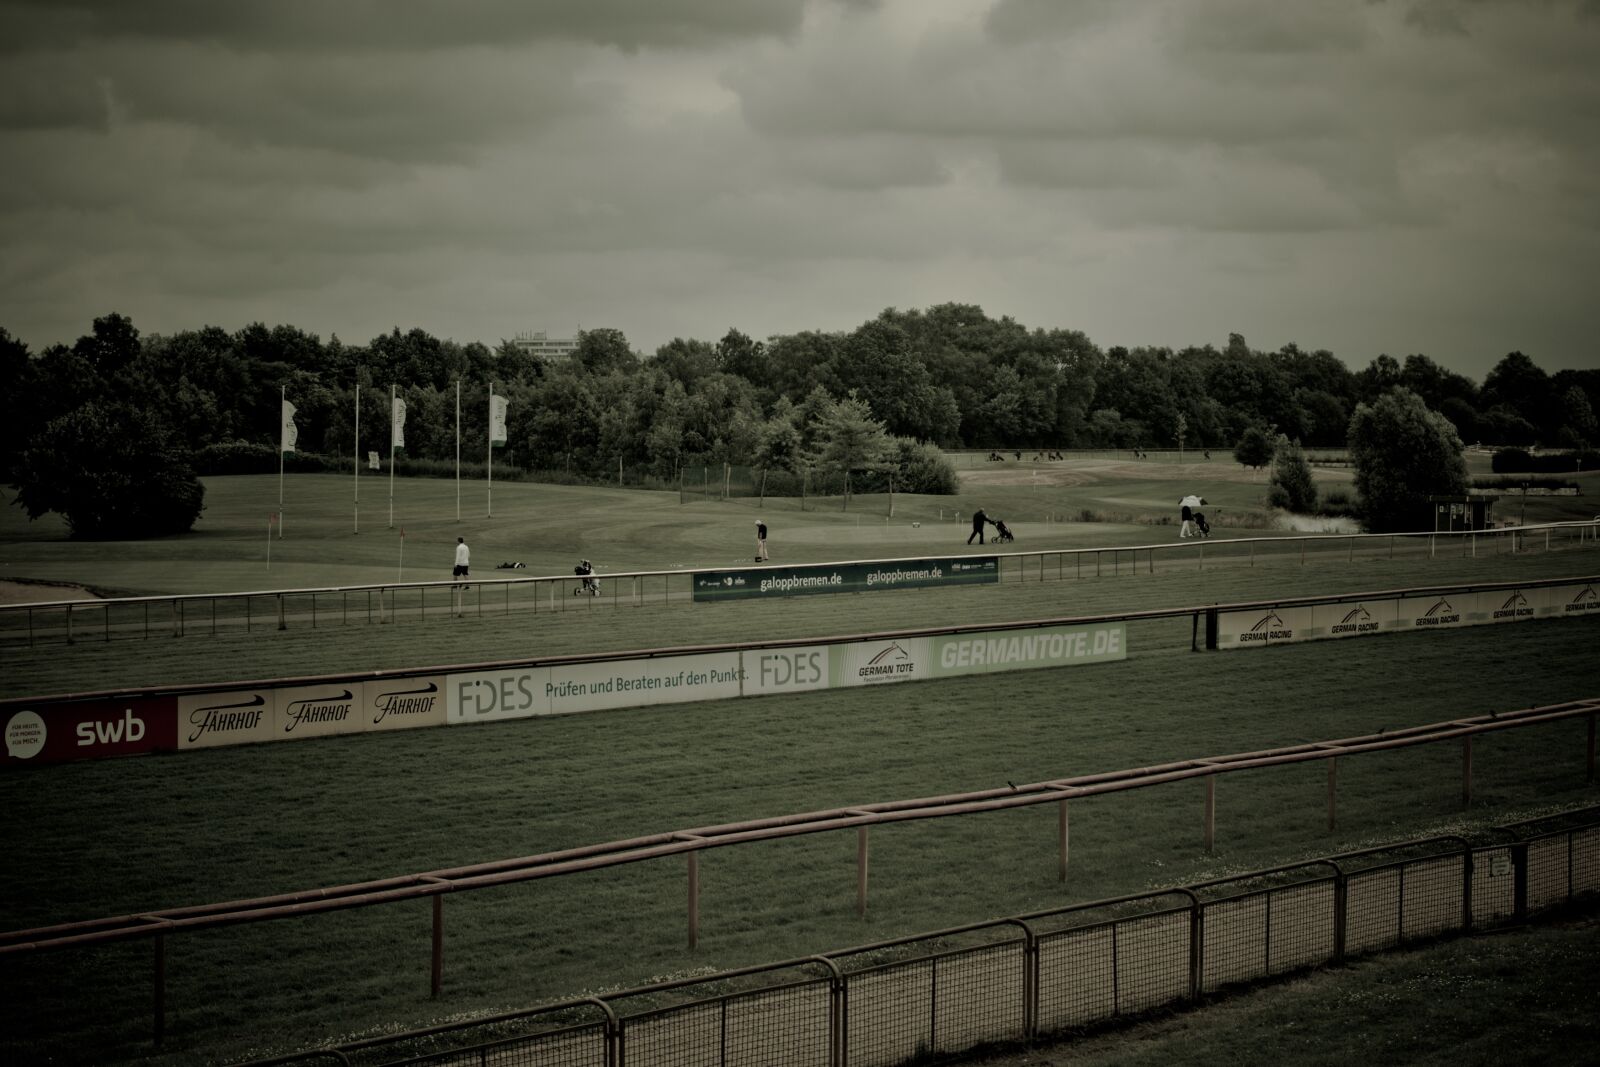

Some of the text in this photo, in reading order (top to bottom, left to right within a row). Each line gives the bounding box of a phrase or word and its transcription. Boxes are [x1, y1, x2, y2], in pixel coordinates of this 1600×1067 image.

[760, 572, 843, 592] galoppbremen.de
[866, 566, 943, 586] galoppbremen.de
[1493, 608, 1534, 619] GERMAN RACING
[1565, 601, 1600, 612] GERMAN RACIN
[1416, 614, 1460, 626] GERMAN RACING
[1331, 622, 1379, 634] GERMAN RACING
[1240, 630, 1292, 642] GERMAN RACING
[941, 628, 1121, 669] GERMANTOTE.DE
[858, 662, 914, 677] GERMAN TOTE
[545, 680, 586, 698] Prüfen
[590, 678, 613, 693] und
[616, 674, 662, 692] Beraten
[664, 671, 684, 688] auf
[686, 670, 707, 686] den
[76, 708, 146, 746] swb
